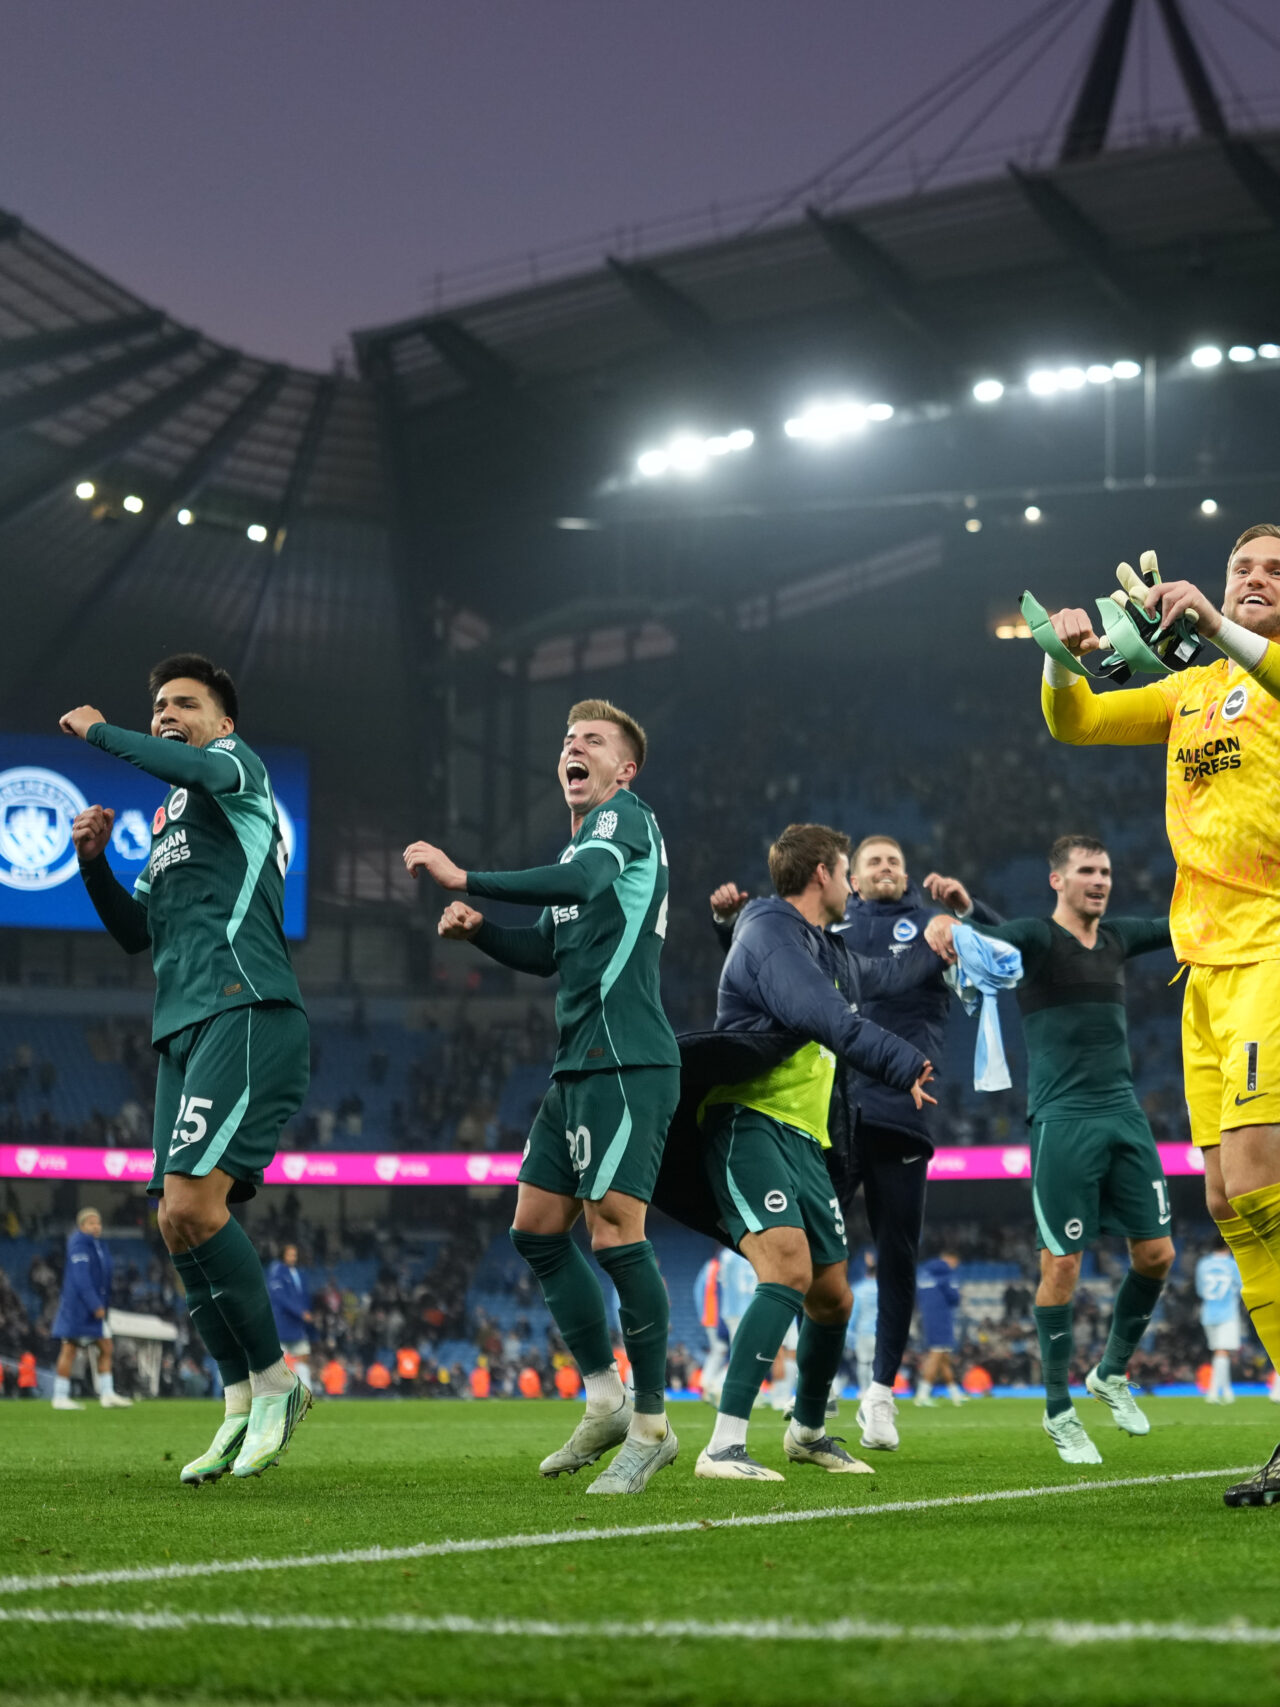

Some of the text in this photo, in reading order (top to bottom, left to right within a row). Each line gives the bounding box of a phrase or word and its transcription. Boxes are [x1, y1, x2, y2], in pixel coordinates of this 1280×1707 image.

[1175, 736, 1240, 763] AMEICAN
[1244, 1041, 1258, 1092] 1
[1152, 1179, 1170, 1215] 1
[1203, 1272, 1233, 1301] 27
